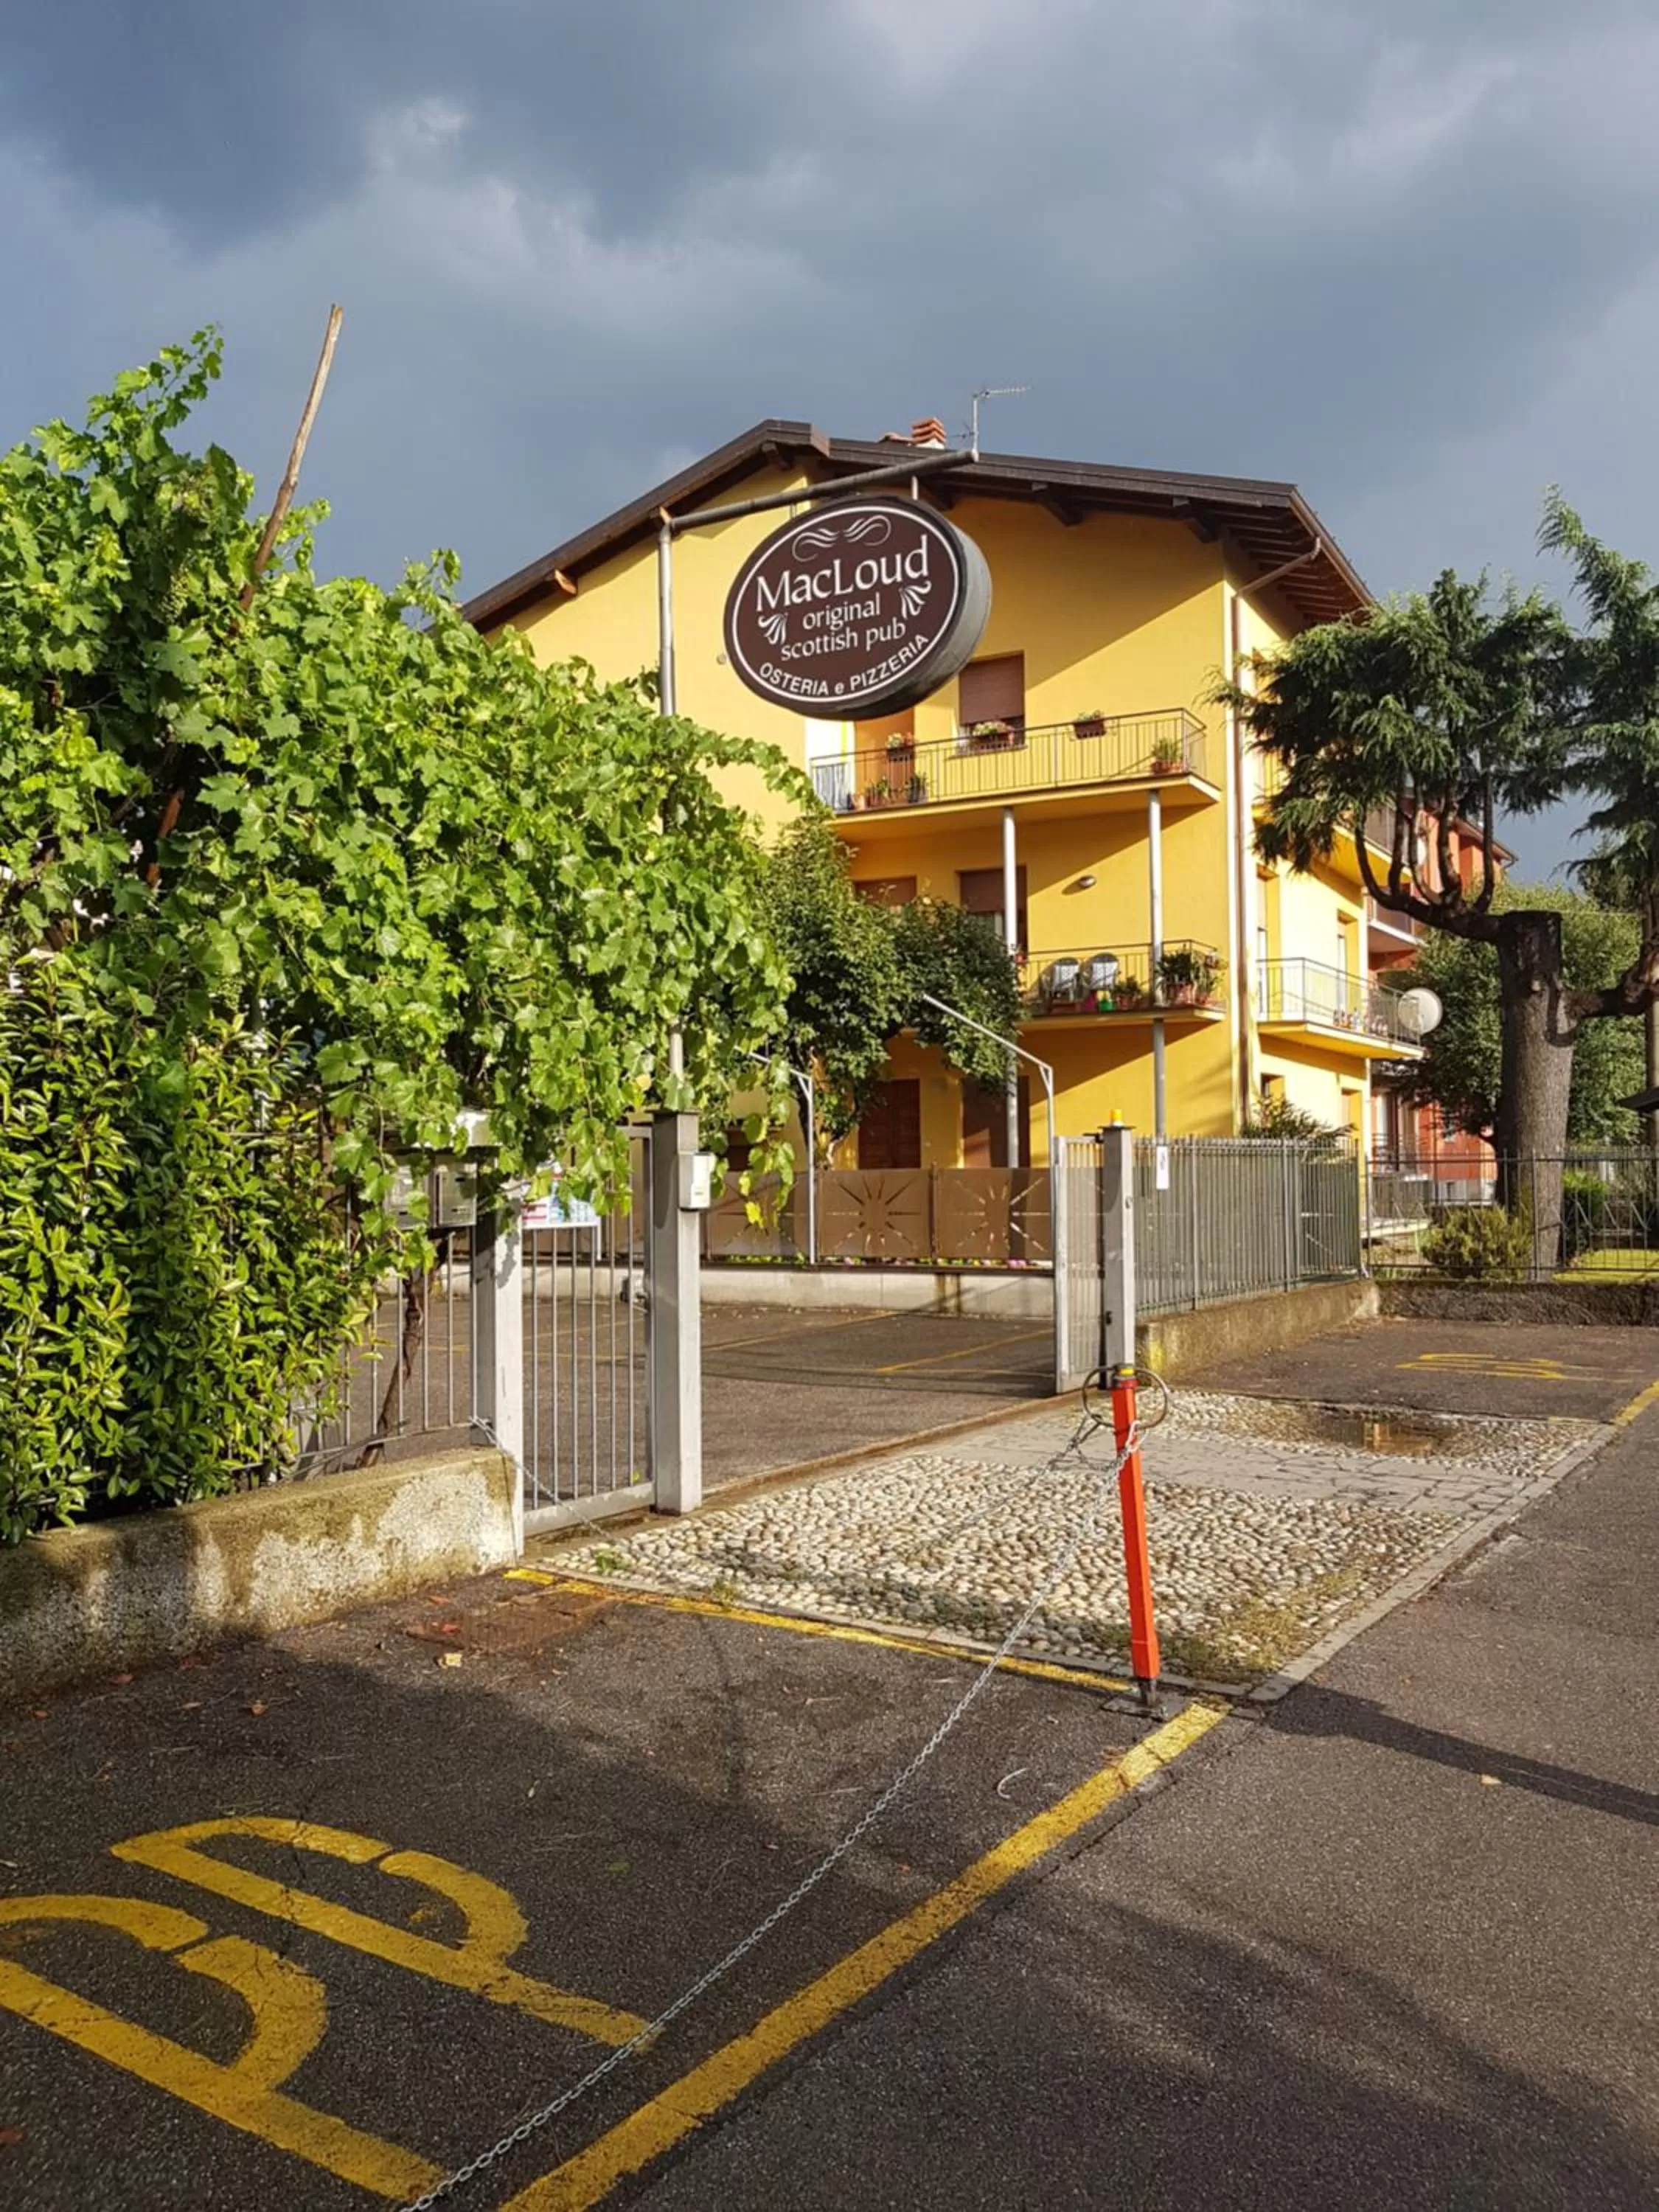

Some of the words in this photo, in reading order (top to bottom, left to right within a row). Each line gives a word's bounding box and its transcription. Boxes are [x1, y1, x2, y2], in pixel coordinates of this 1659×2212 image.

[756, 534, 929, 612] MacLoud
[802, 592, 881, 630] original
[759, 662, 829, 696] OSTERIA
[834, 684, 845, 695] e
[849, 633, 930, 691] PIZZERIA
[780, 629, 859, 661] scottish
[866, 620, 906, 652] pub
